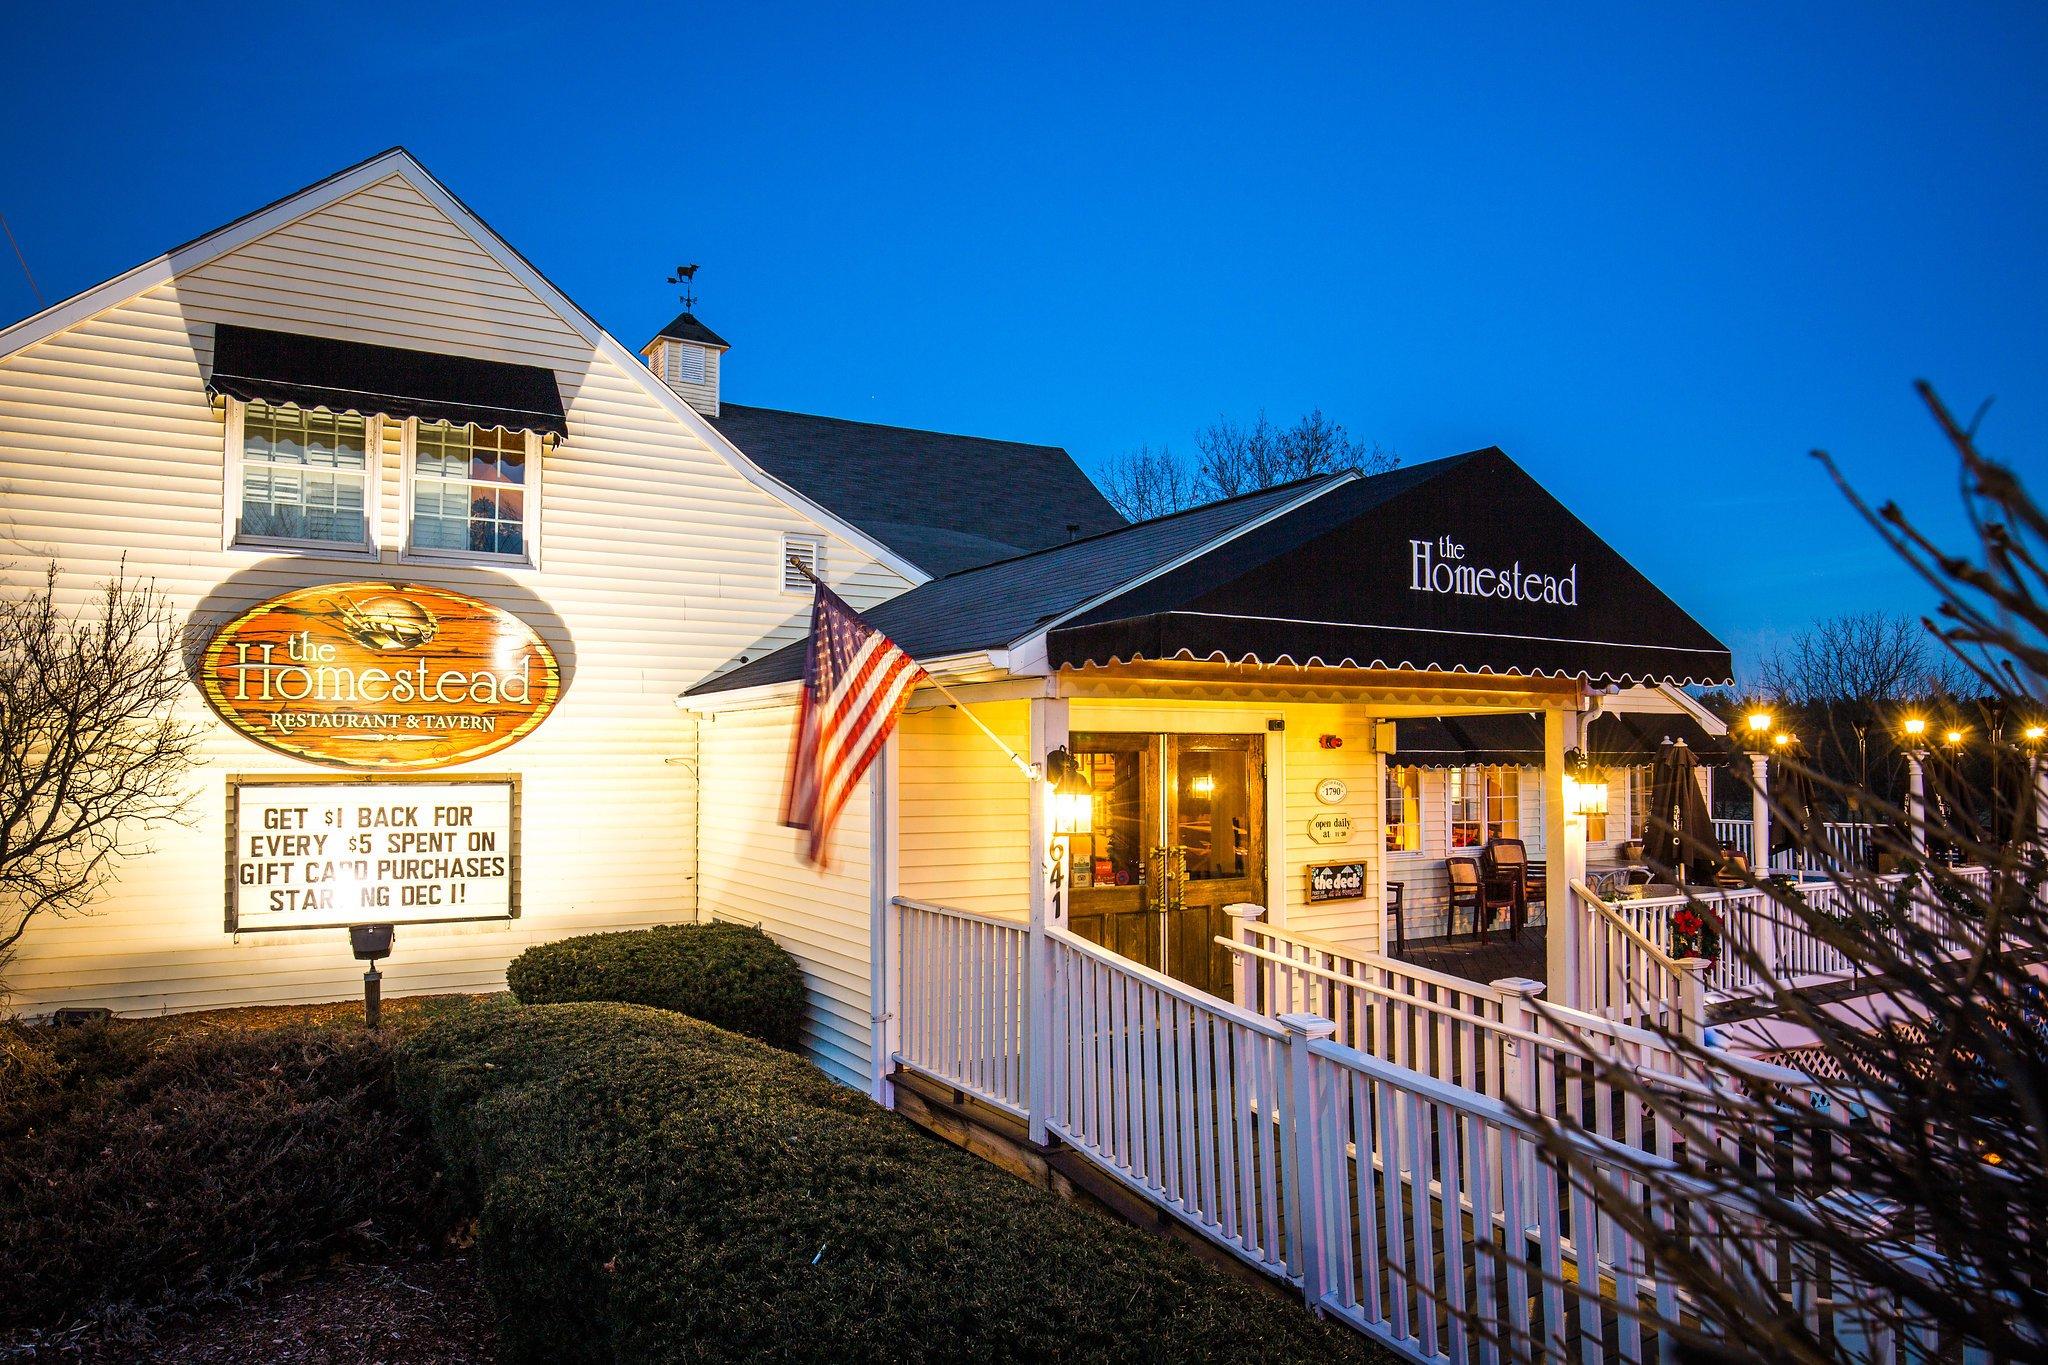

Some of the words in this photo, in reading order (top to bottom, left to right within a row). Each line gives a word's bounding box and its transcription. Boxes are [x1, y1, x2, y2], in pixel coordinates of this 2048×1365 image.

[1438, 534, 1465, 560] the
[1409, 539, 1578, 606] Homestead
[288, 630, 336, 662] the
[230, 643, 532, 705] Homestead
[270, 713, 400, 735] RESTAURANT
[405, 714, 419, 729] &
[423, 715, 496, 733] TAVERN
[1325, 787, 1341, 796] 1790
[264, 808, 308, 830] GET
[325, 807, 343, 829] $1
[358, 806, 418, 828] BACK
[433, 806, 473, 827] FOR
[1315, 820, 1331, 830] open
[1333, 818, 1351, 829] daily
[251, 834, 328, 858] EVERY
[349, 833, 372, 854] $5
[387, 832, 457, 853] SPENT
[468, 831, 495, 852] ON
[240, 862, 294, 885] GIFT
[377, 857, 505, 880] PURCHASES
[1314, 874, 1333, 890] the
[1333, 872, 1361, 889] deck
[270, 886, 390, 912] STARNG
[401, 884, 442, 907] DEC
